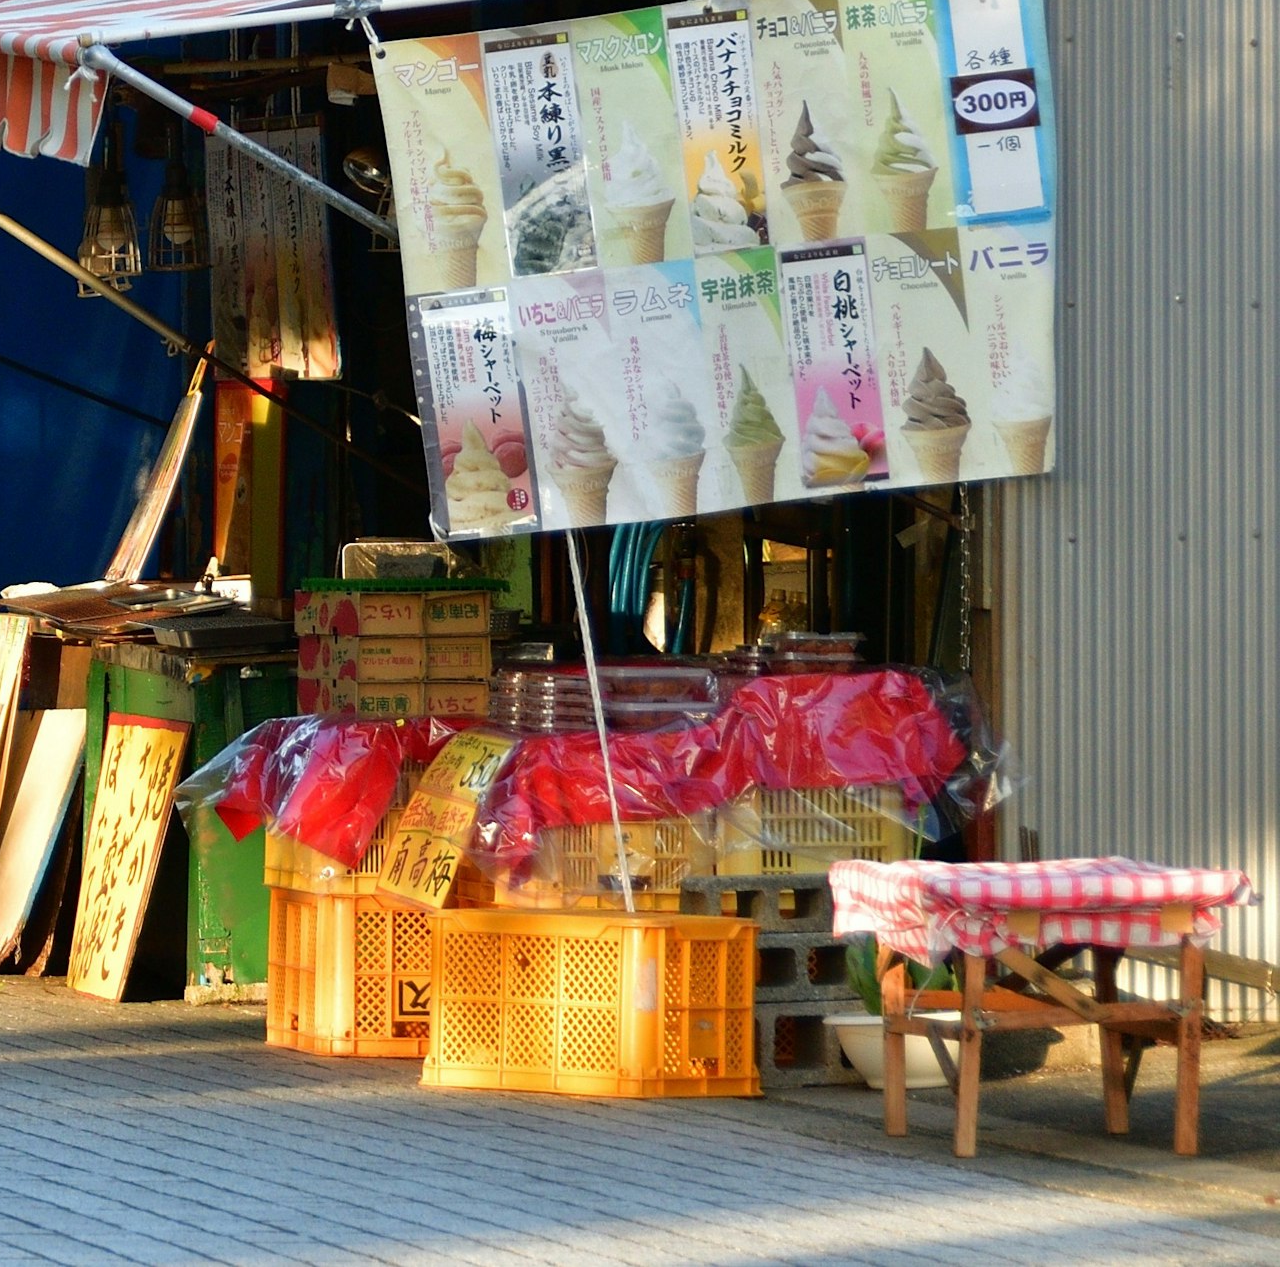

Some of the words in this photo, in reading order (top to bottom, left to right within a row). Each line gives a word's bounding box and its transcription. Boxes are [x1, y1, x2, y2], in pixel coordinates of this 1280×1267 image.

[576, 32, 663, 64] マスクメロン
[706, 38, 716, 72] Banana
[803, 48, 830, 57] Vanilla
[895, 38, 923, 47] Vanilla
[393, 56, 479, 87] マンゴー
[600, 64, 620, 73] Musk
[621, 61, 644, 70] Melon
[964, 46, 1014, 70] 各種
[524, 61, 534, 86] Black
[710, 73, 719, 102] Choco
[424, 87, 452, 96] Mango
[528, 87, 538, 123] Sesame
[715, 31, 747, 173] バナナチョコミルク
[962, 90, 1027, 114] 300円
[714, 103, 722, 122] Milk
[532, 125, 541, 142] Soy
[590, 86, 612, 182] 国産マスクメロン使用
[872, 251, 959, 282] チョコレート
[969, 242, 1049, 272] バニラ
[700, 270, 774, 304] 宇治抹茶
[900, 281, 939, 291] Chocolate
[1000, 272, 1028, 281] Vanilla
[613, 282, 694, 316] ラムネ
[552, 334, 579, 344] Vanilla
[832, 269, 862, 410] 白桃シャーベット
[473, 316, 502, 424] 梅シャーベット
[712, 353, 729, 428] 深みのある味わい
[363, 604, 412, 621] いちご
[427, 696, 478, 714] いちご
[386, 834, 456, 898] 南高梅
